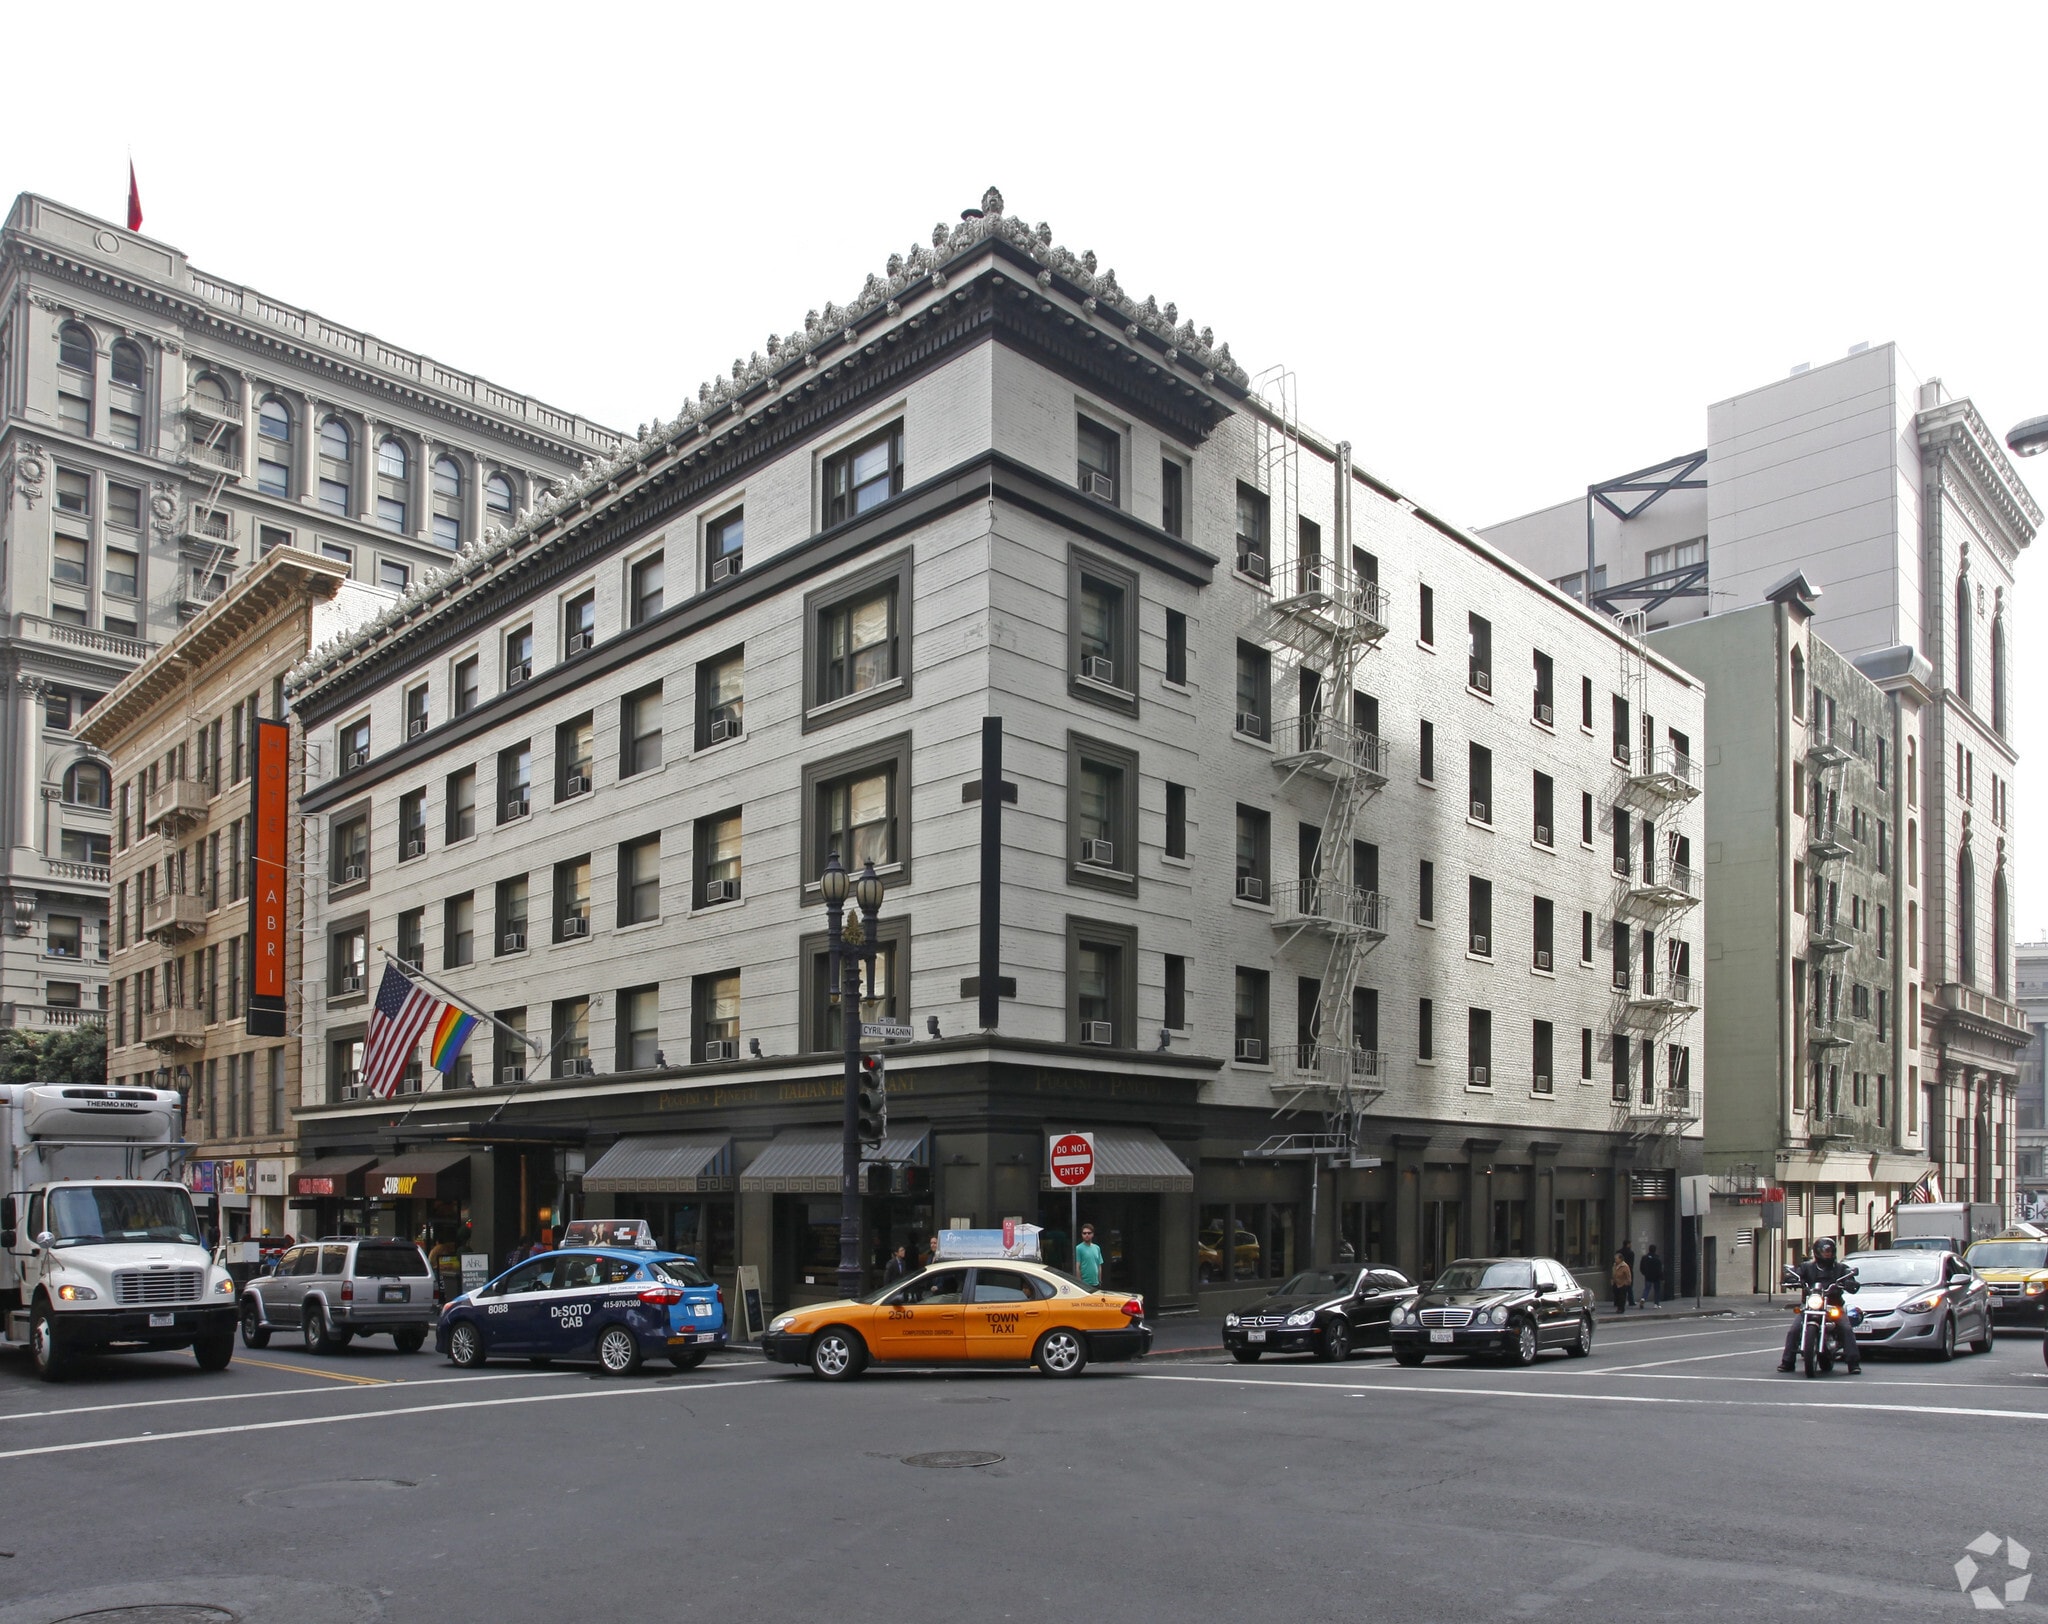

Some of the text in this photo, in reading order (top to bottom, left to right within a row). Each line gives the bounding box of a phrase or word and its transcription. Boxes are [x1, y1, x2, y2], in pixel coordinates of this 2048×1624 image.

[266, 889, 277, 983] ABRI
[863, 1025, 911, 1037] CYRIL MAGNIN
[778, 1081, 826, 1100] ITALIAN
[831, 1074, 917, 1096] REANT
[87, 1100, 138, 1109] THERMO KING
[1056, 1143, 1087, 1154] DO NOT
[1060, 1166, 1085, 1177] ENTER
[382, 1175, 417, 1195] SUBWAY
[657, 1274, 685, 1288] 8088
[488, 1303, 509, 1315] 8088
[602, 1299, 641, 1309] 415-970-1300
[888, 1310, 914, 1321] 2510
[985, 1313, 1019, 1323] TOWN
[561, 1315, 583, 1329] CAB
[990, 1323, 1015, 1334] TAXI
